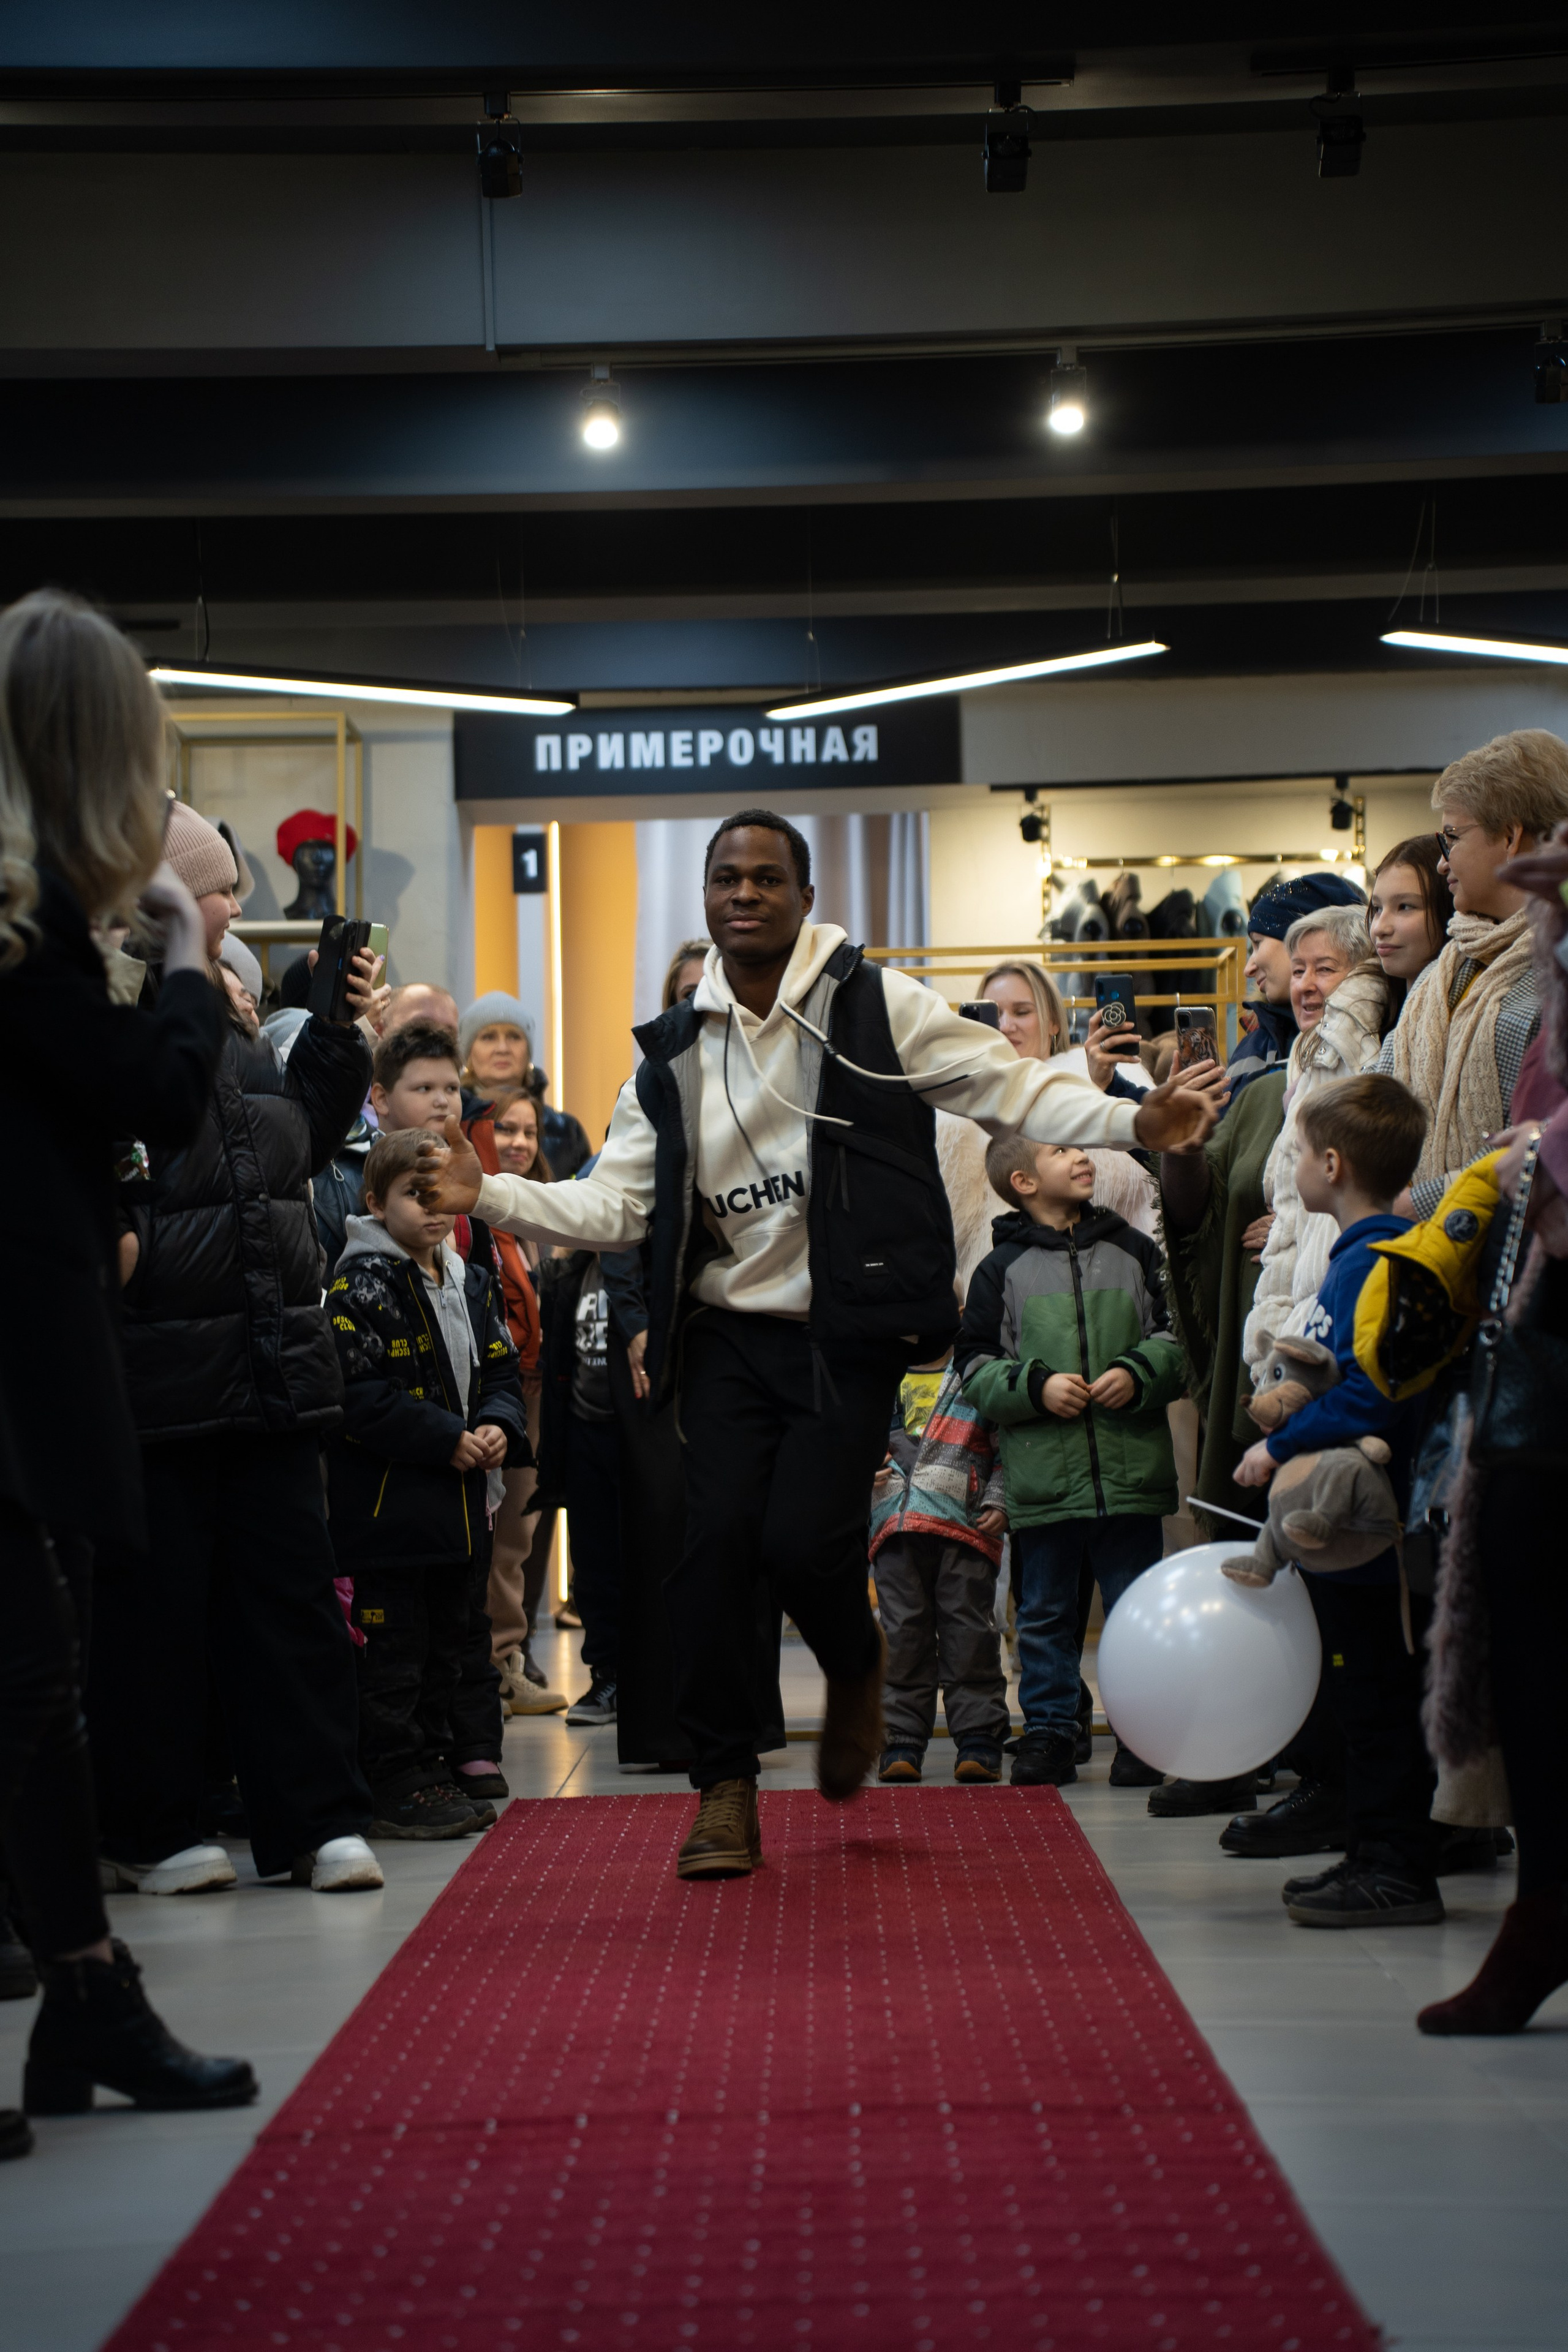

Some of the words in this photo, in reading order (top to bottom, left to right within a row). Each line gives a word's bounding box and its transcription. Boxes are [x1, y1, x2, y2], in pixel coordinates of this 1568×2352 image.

[535, 724, 878, 772] ПРИМЕРОЧНАЯ
[521, 848, 538, 878] 1
[391, 1338, 407, 1349] CLUB
